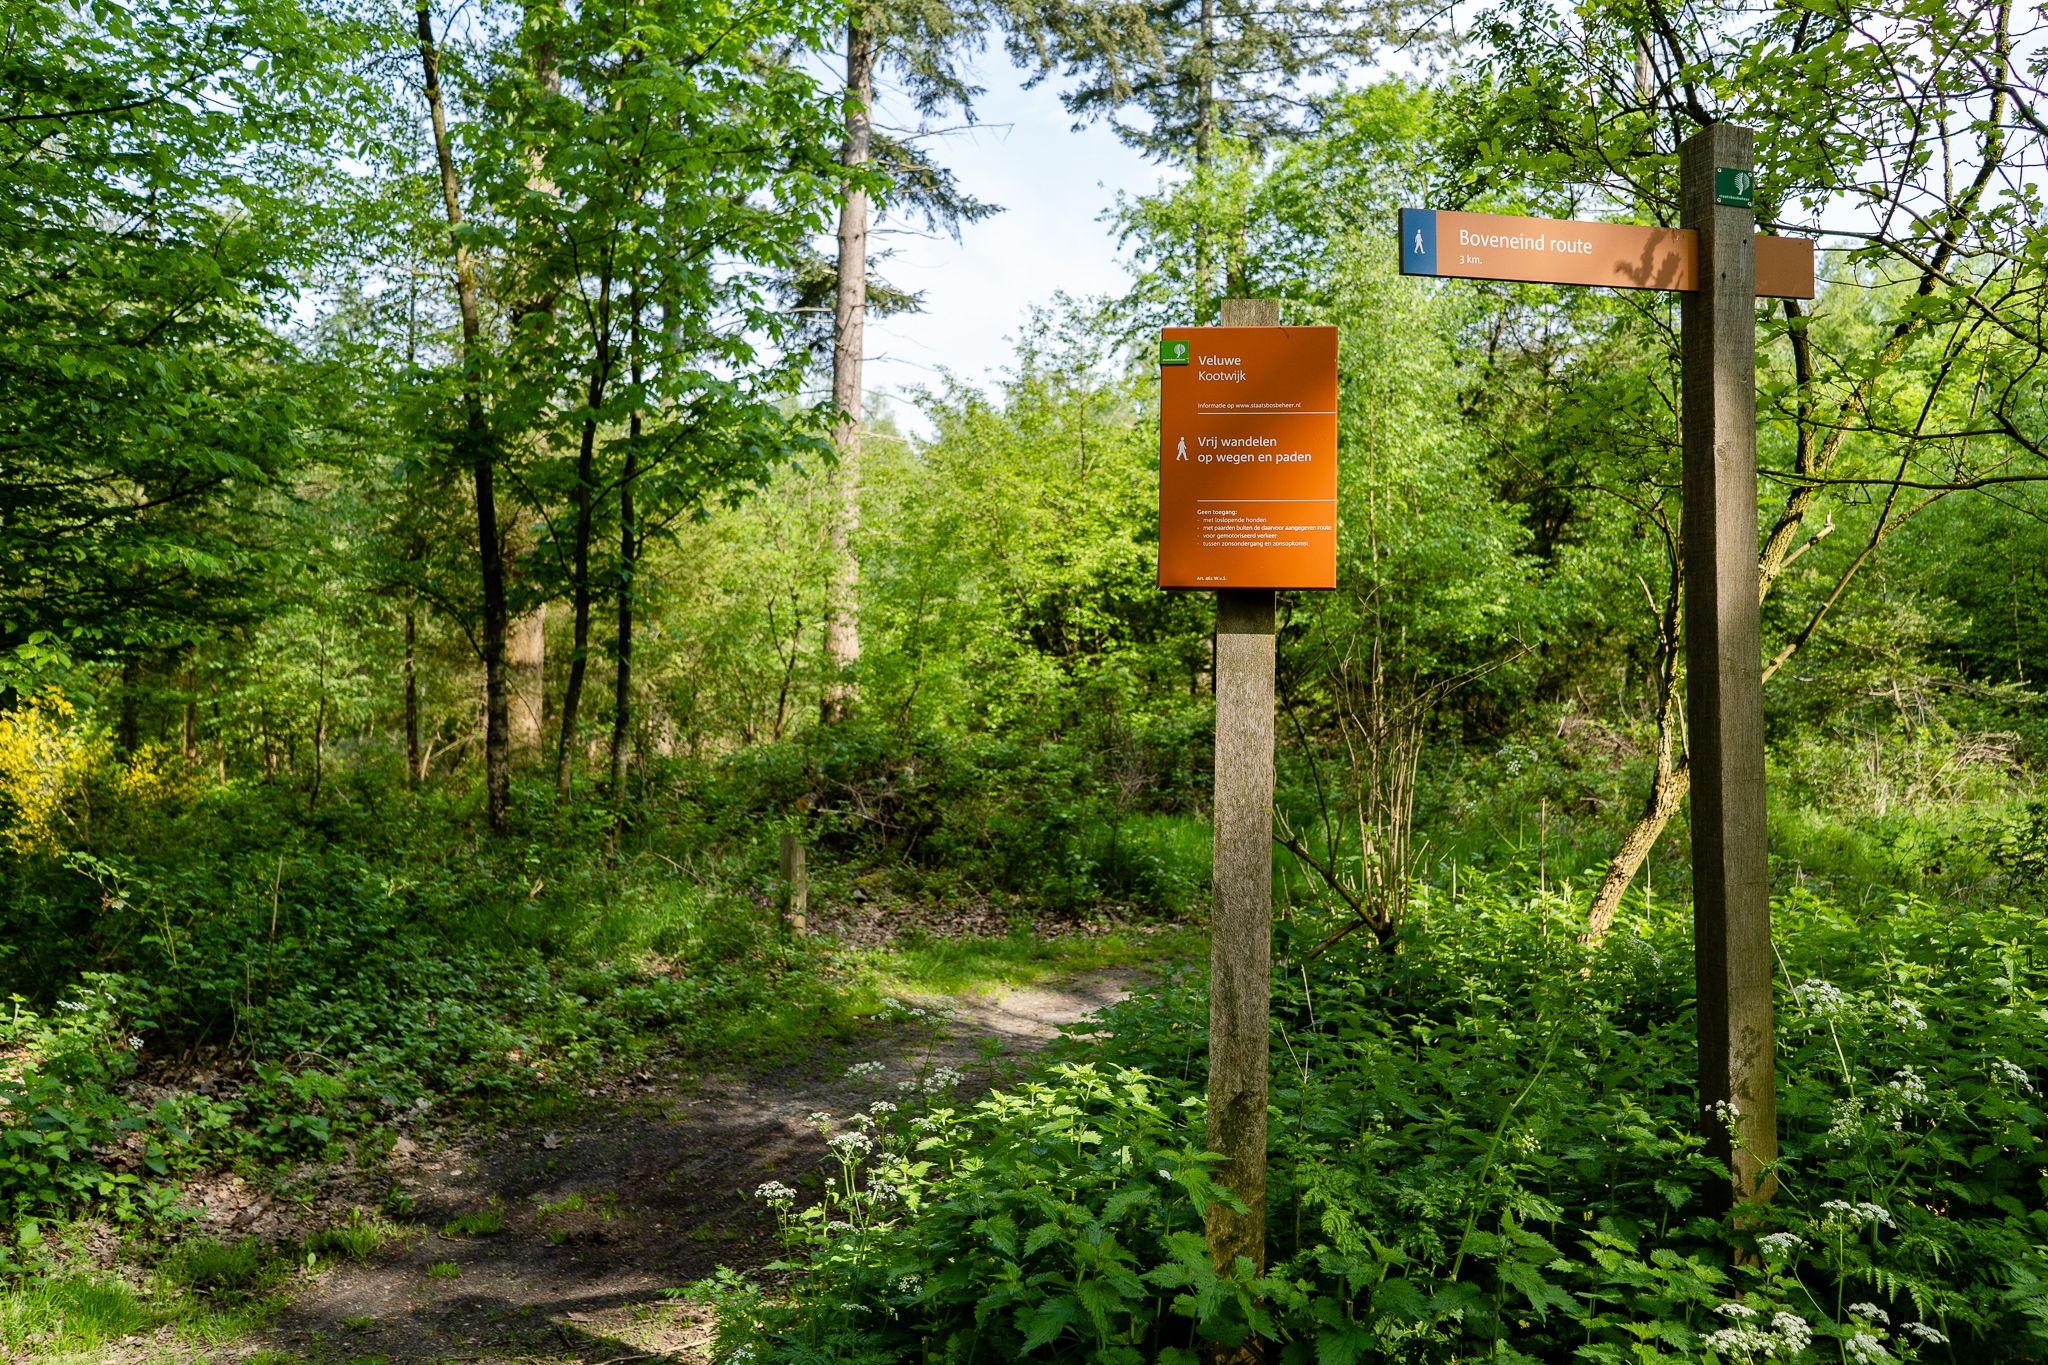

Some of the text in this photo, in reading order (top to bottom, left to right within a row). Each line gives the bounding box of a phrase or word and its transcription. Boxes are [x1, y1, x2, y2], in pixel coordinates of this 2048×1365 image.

[1459, 229, 1592, 255] Boveneind route
[1459, 255, 1483, 265] 3 km.
[1198, 355, 1241, 366] Veluwe
[1198, 370, 1246, 383] Kootwijk
[1198, 436, 1277, 449] Vrij wandelen
[1198, 452, 1312, 465] op wegen en paden
